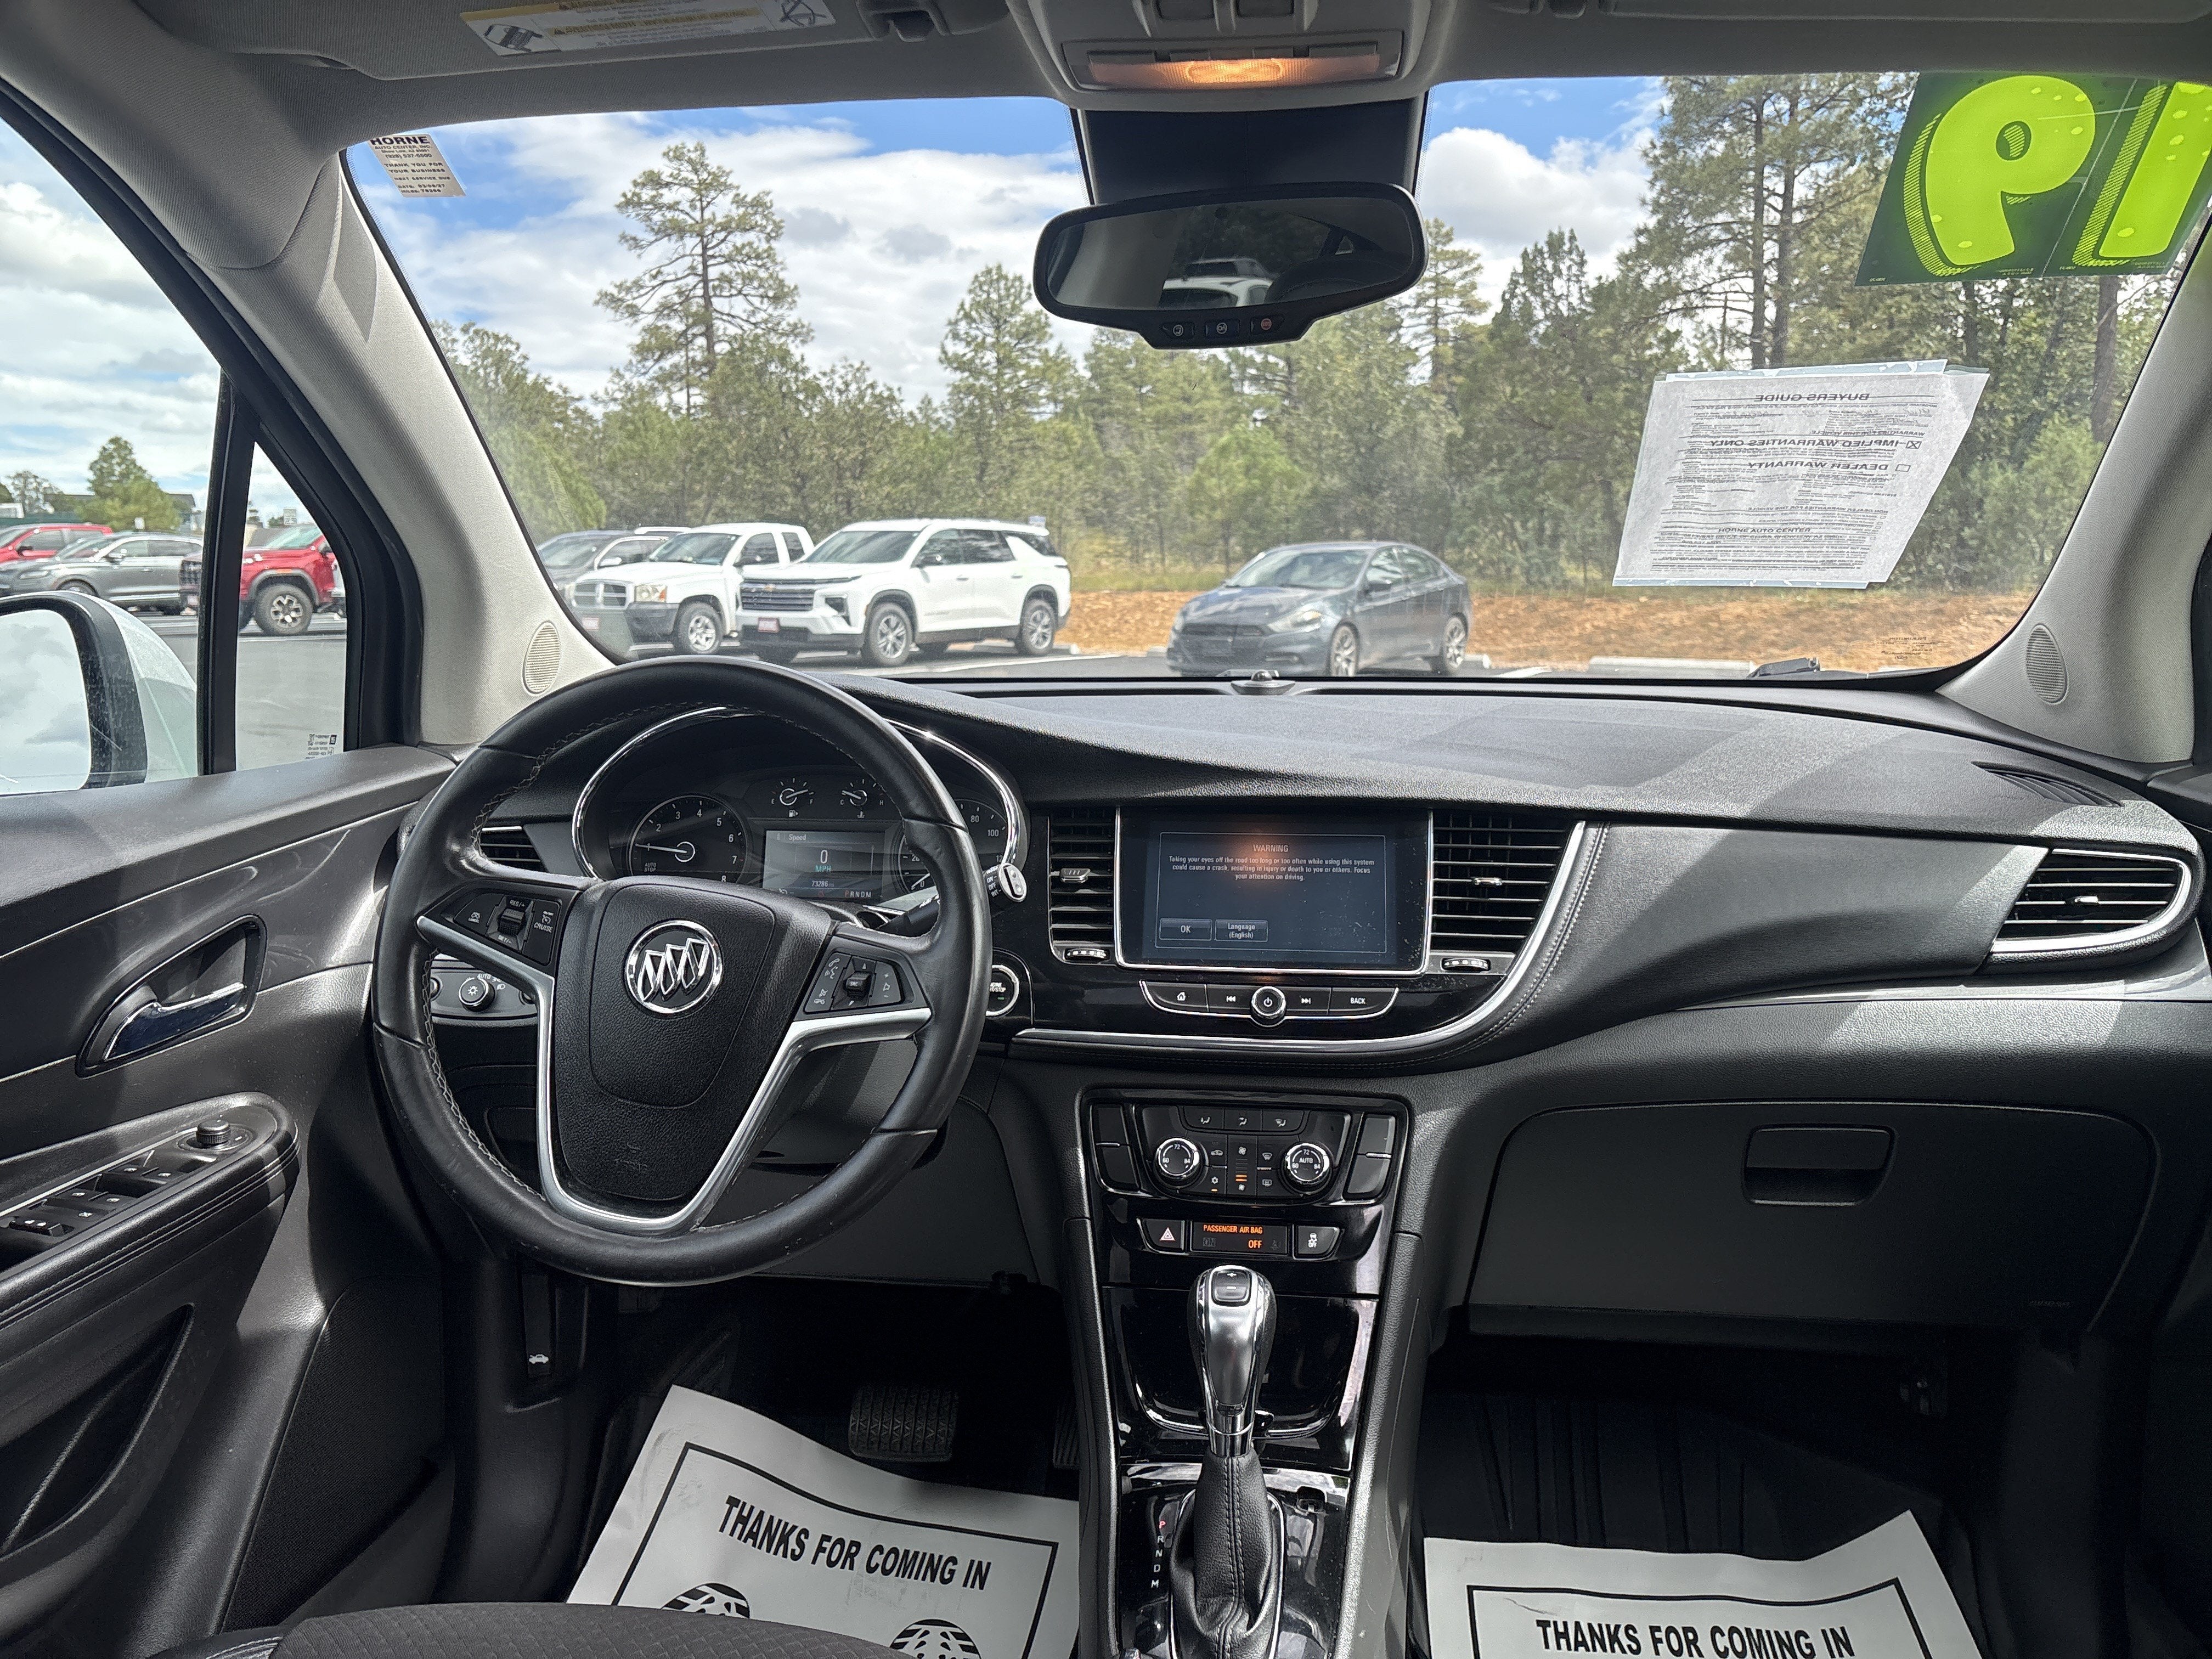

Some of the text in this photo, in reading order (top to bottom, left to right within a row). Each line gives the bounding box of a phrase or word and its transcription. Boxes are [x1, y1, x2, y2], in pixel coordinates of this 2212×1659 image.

[370, 136, 430, 145] HORNE
[675, 811, 681, 820] 3
[696, 809, 702, 817] 4
[716, 817, 722, 826] 5
[656, 823, 662, 832] 2
[788, 833, 806, 842] Speed
[988, 829, 999, 837] 100
[728, 834, 734, 843] 6
[1254, 844, 1289, 853] WARNING
[732, 855, 737, 864] 7
[820, 849, 828, 864] 0
[534, 922, 554, 933] CRUISE
[1180, 925, 1191, 933] OK
[1227, 923, 1256, 931] Language
[1228, 931, 1254, 939] (English)
[1203, 1224, 1263, 1234] PASSENGER AIR BAG
[1204, 1238, 1215, 1246] ON
[1248, 1239, 1262, 1249] OFF
[718, 1494, 991, 1591] THANKS FOR COMING IN
[1154, 1564, 1161, 1572] D
[1151, 1580, 1159, 1588] M
[1536, 1619, 1856, 1659] THANKS FOR COMING IN
